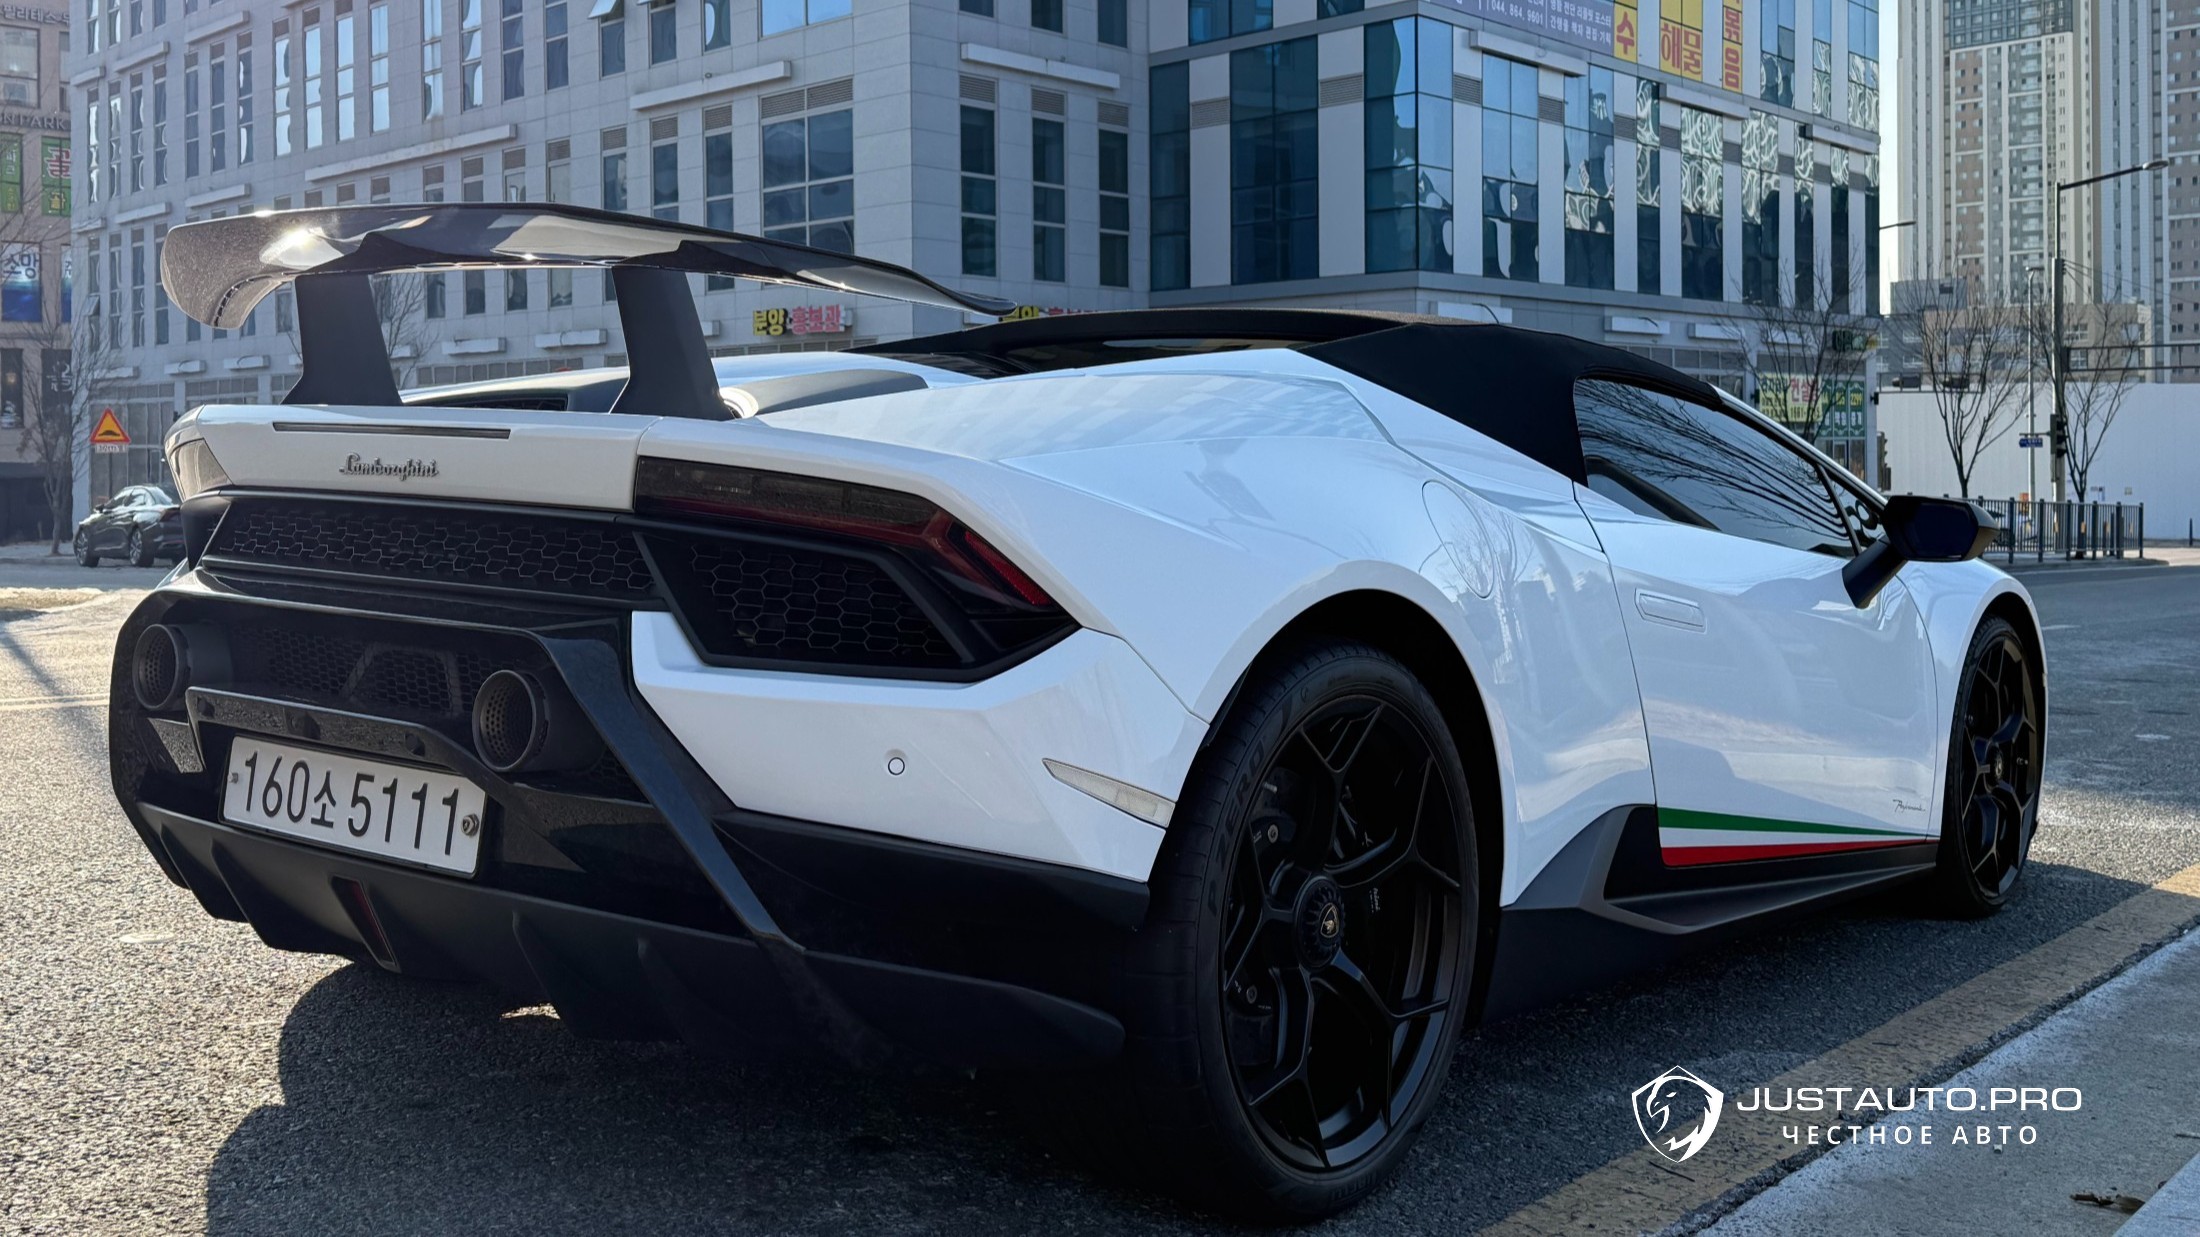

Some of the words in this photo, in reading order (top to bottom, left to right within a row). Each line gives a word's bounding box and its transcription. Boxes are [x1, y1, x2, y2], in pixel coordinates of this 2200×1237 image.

[1527, 9, 1543, 25] 9601
[1595, 11, 1611, 28] 포스터
[1661, 23, 1701, 75] 해물
[1723, 0, 1740, 89] 볶음
[3, 253, 39, 279] 소망
[753, 308, 784, 336] 분양
[339, 452, 439, 481] Lamborghini
[244, 751, 337, 828] 160소
[347, 772, 460, 856] 5111
